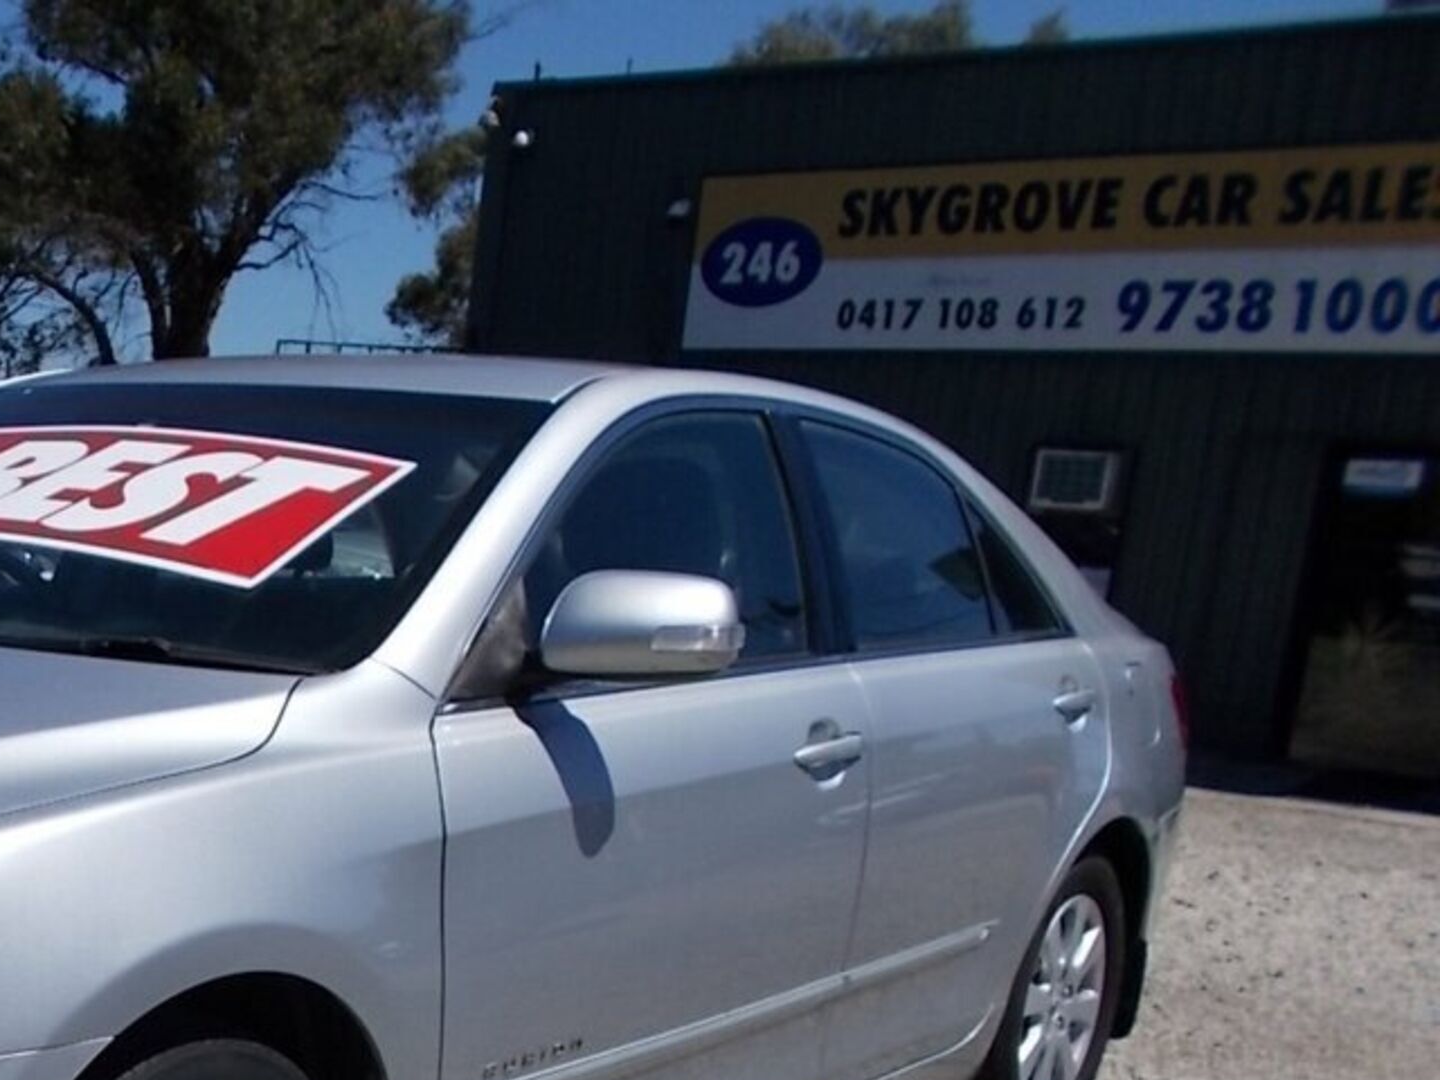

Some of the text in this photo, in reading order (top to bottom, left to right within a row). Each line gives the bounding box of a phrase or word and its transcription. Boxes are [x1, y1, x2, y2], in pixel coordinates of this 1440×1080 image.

[838, 163, 1440, 238] SKYGROVE CAR SALE
[720, 241, 801, 285] 246
[837, 297, 1085, 331] 0417 108 612
[1117, 279, 1276, 334] 9738
